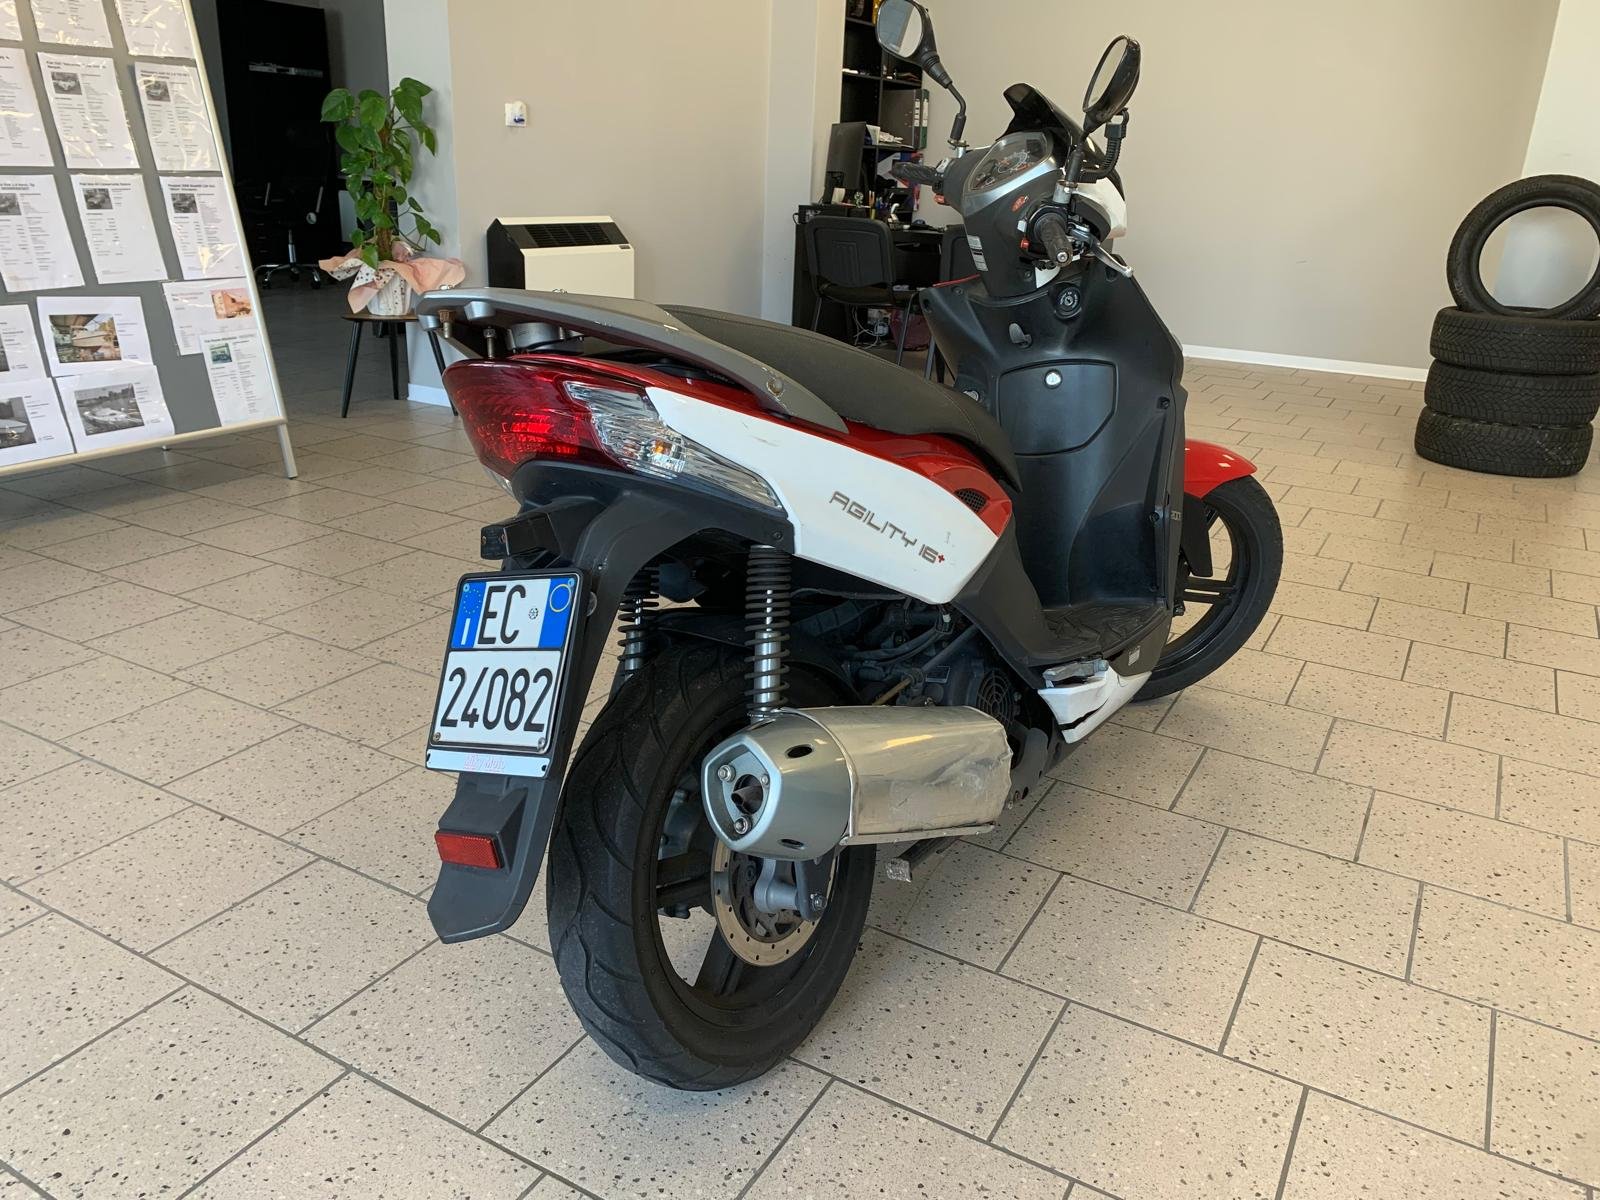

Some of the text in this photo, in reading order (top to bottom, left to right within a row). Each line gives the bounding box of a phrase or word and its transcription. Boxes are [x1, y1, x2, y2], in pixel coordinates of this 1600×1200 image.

[829, 491, 917, 547] AGILITY
[478, 585, 527, 645] EC
[440, 667, 553, 732] 24082
